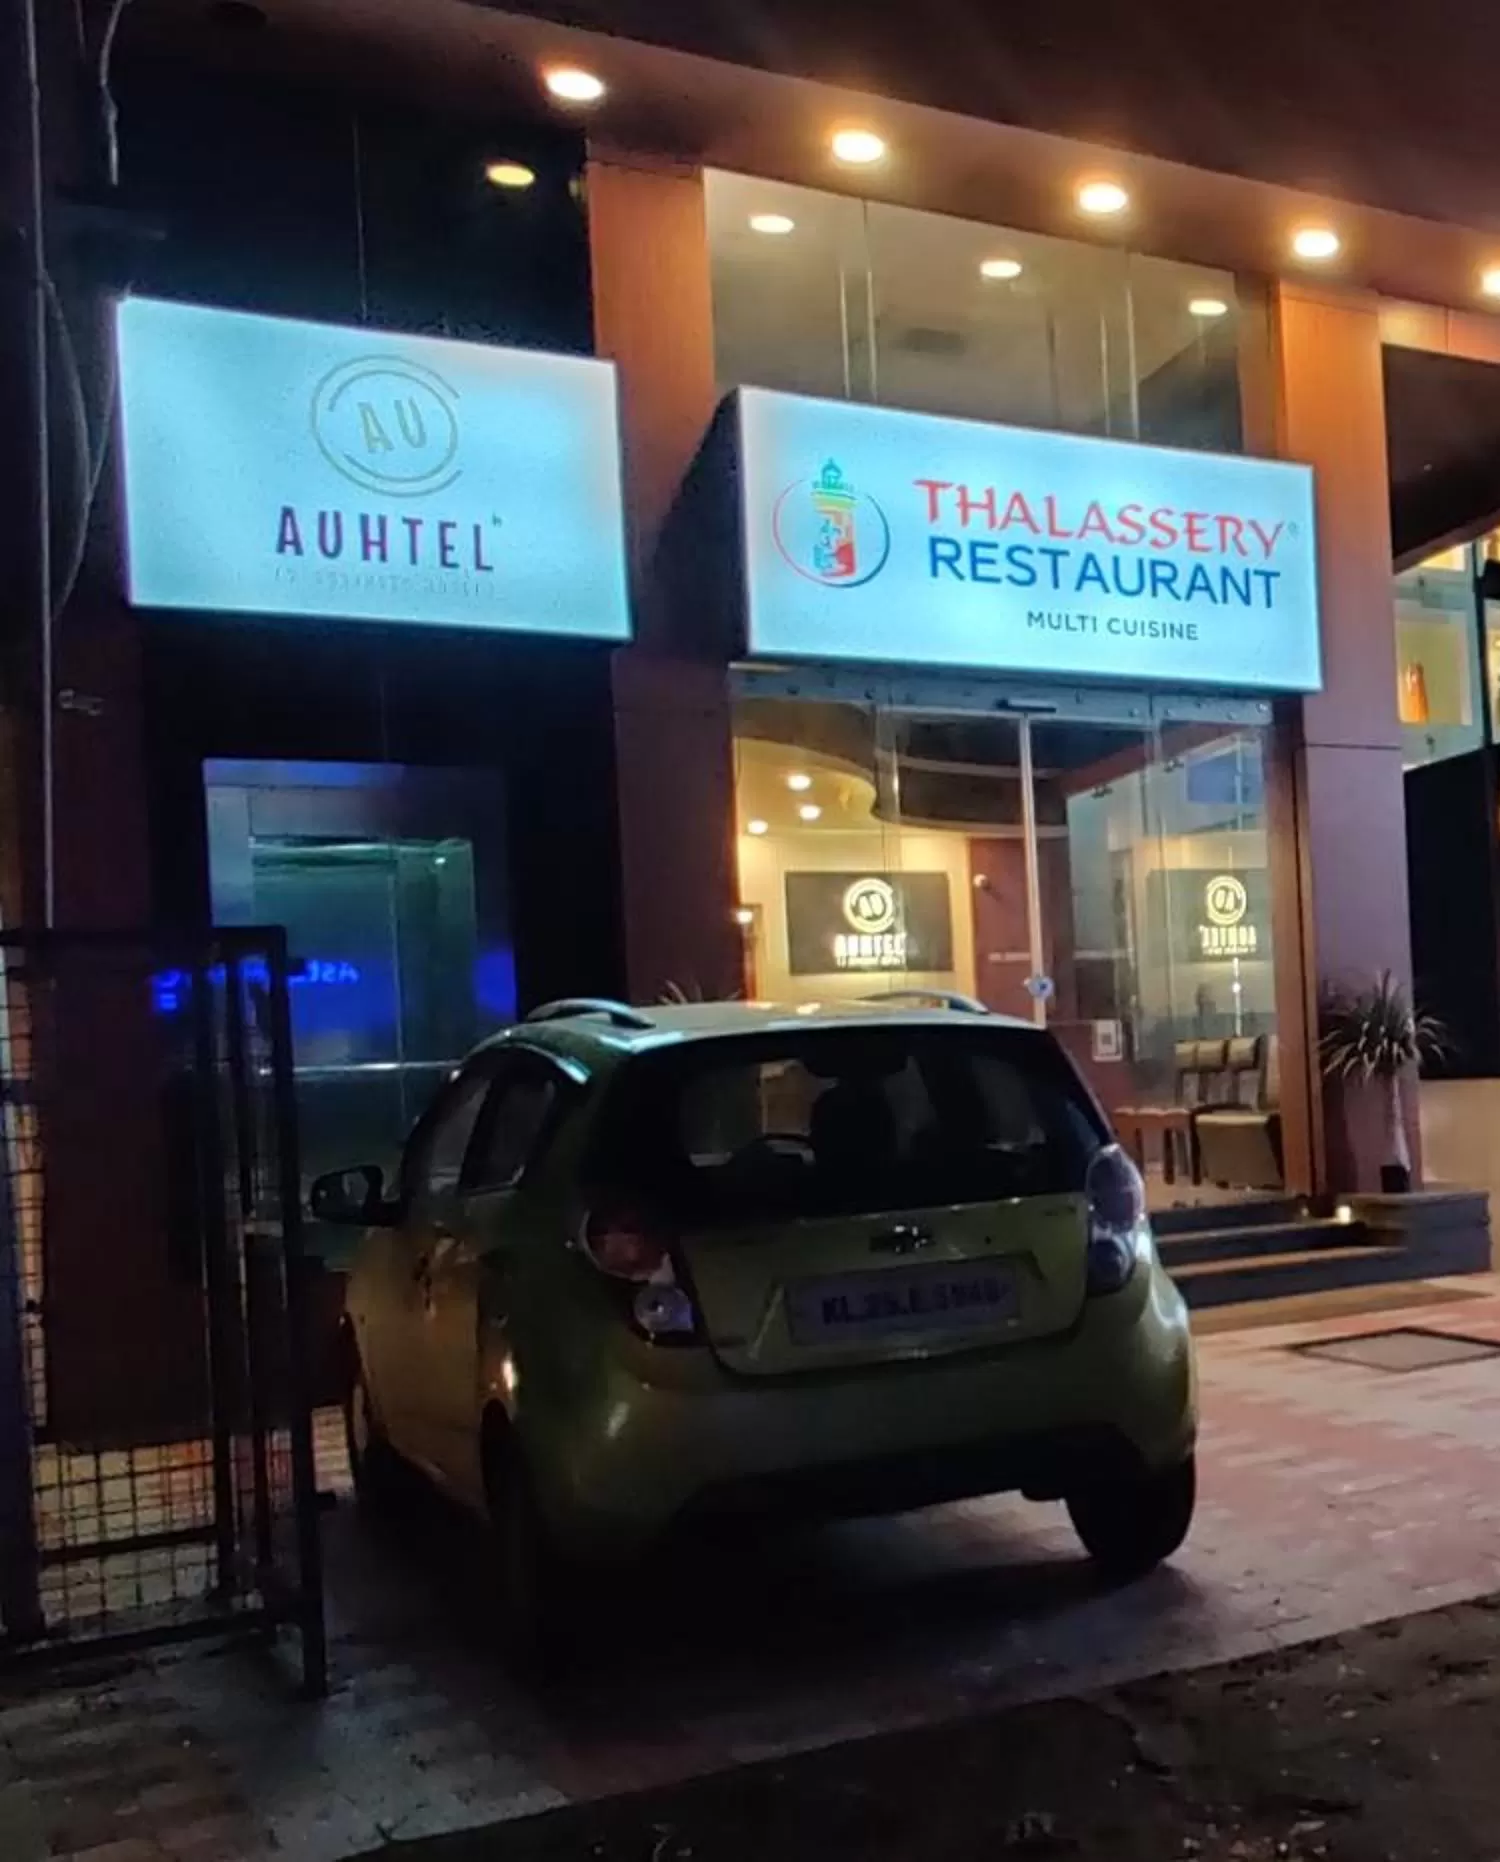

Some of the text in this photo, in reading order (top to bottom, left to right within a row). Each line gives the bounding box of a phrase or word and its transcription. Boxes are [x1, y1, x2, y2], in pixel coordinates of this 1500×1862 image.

[357, 397, 428, 454] AU
[275, 505, 494, 572] AUHTEL
[913, 478, 1284, 560] THALASSERY
[928, 536, 1281, 609] RESTAURANT
[1027, 610, 1199, 641] MULTI CUISINE
